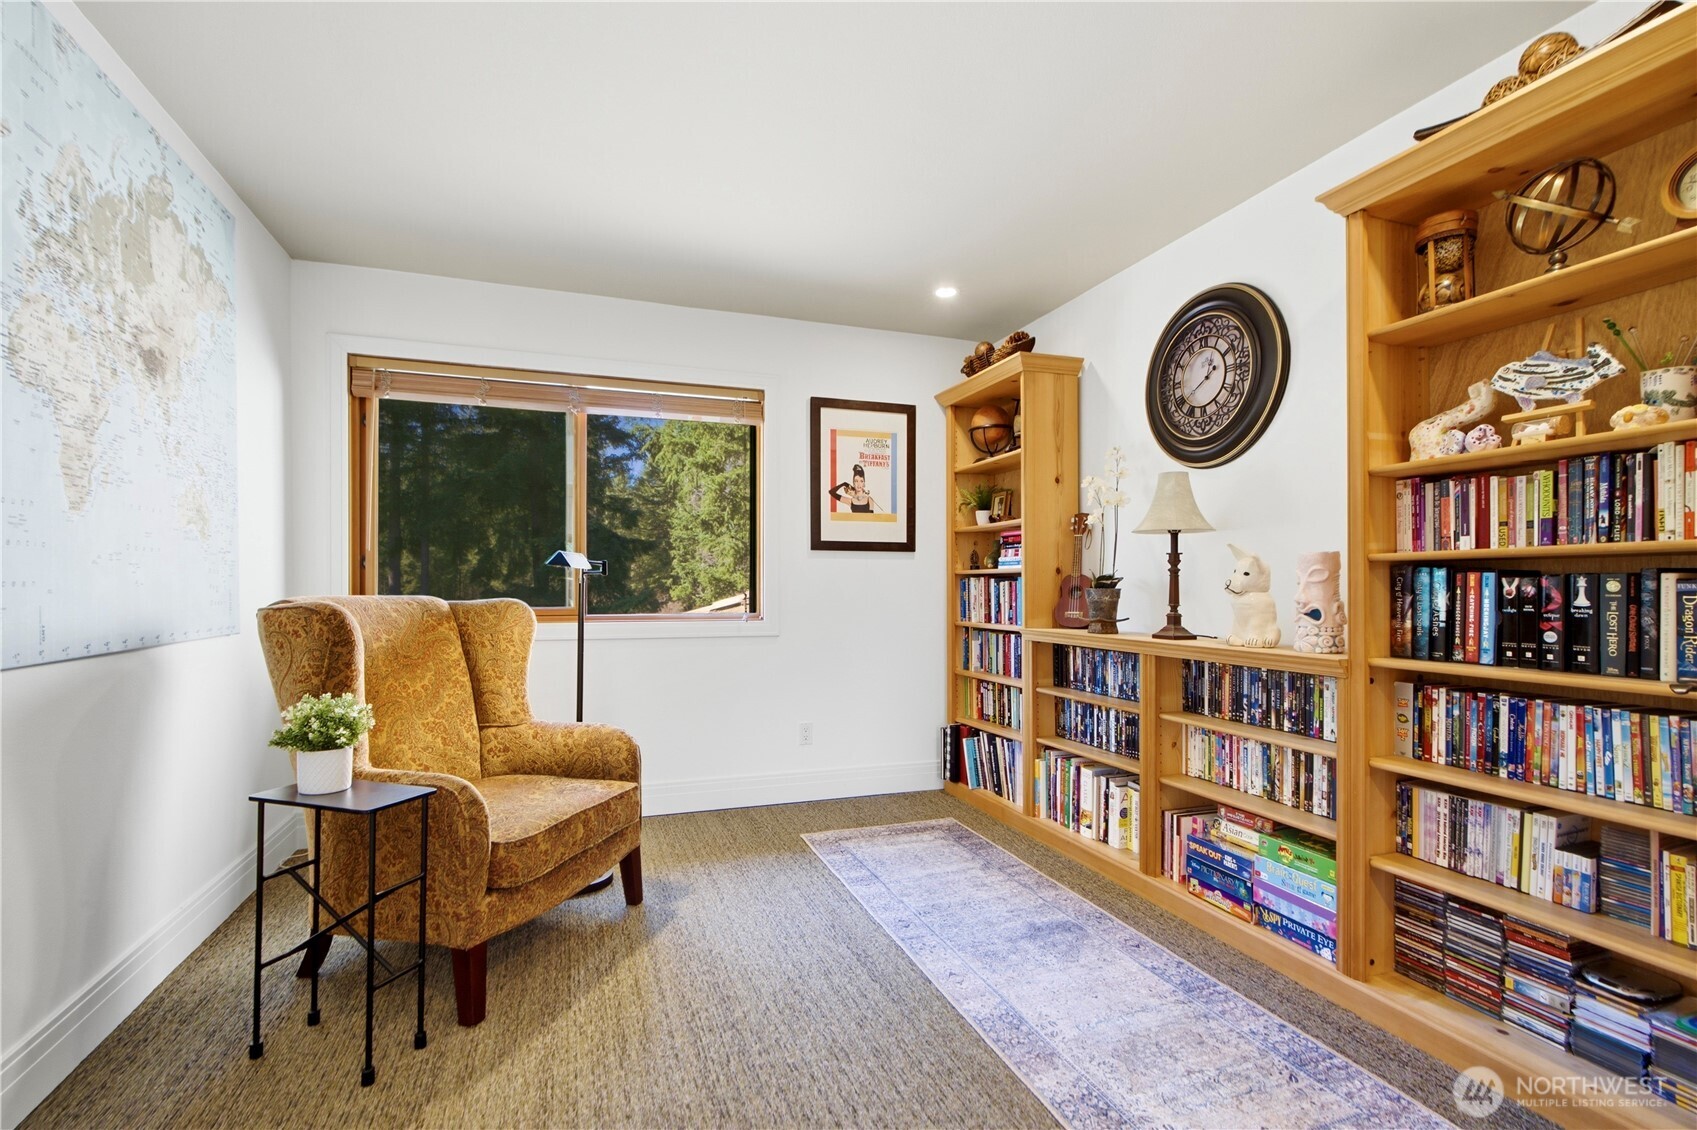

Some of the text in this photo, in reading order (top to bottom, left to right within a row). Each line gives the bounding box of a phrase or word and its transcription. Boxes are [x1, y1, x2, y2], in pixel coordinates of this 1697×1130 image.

[858, 452, 890, 461] BREAKFAST
[1542, 473, 1551, 518] WHODUNITS
[1395, 576, 1403, 591] City
[1395, 598, 1403, 628] Heavenly
[1609, 601, 1618, 611] THE
[1432, 610, 1440, 637] Ashes
[1606, 611, 1619, 632] LOST
[1680, 595, 1697, 664] Dragon Rider
[1606, 632, 1619, 657] HERO
[1222, 823, 1243, 839] Asian
[1189, 841, 1222, 861] SPEAK OUT
[1200, 865, 1236, 886] PICTIONARY
[1266, 860, 1318, 891] Brain Quest
[1282, 917, 1316, 941] PRIVATE
[1317, 935, 1335, 950] EYE
